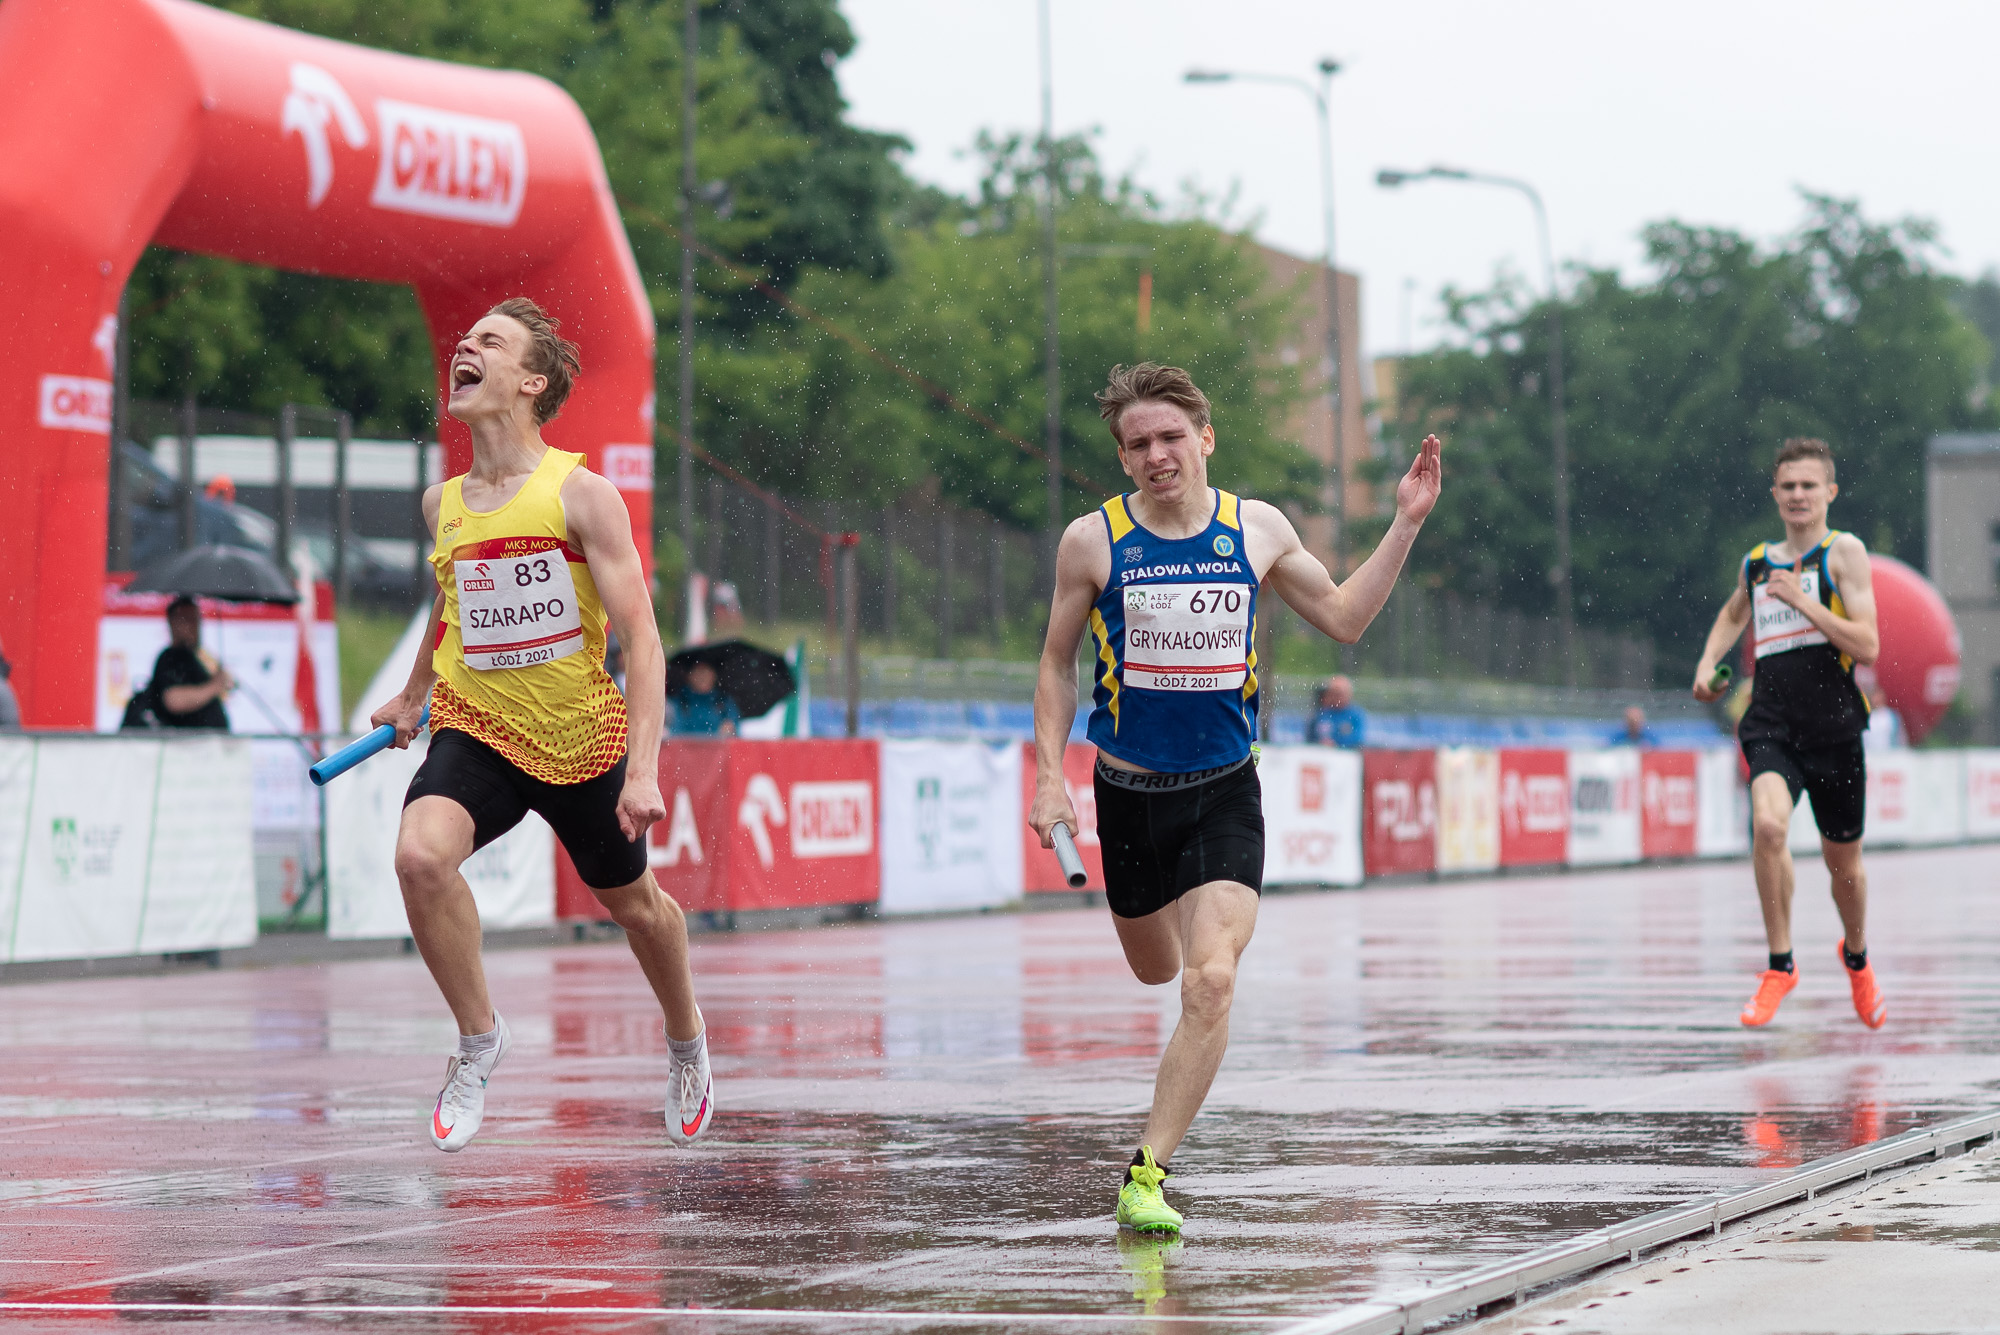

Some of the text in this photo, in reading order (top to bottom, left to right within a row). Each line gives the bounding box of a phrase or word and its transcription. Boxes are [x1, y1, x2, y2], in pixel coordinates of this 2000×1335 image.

[504, 540, 557, 551] MKS MOS
[514, 559, 551, 587] 83
[1121, 561, 1242, 583] STALOWA WOLA
[465, 581, 493, 591] ORLEN
[1190, 590, 1241, 614] 670
[469, 598, 564, 629] SZARAPO
[1130, 629, 1242, 650] GRYKAŁOWSKI
[491, 648, 555, 667] ŁÓDŹ 2021
[1153, 674, 1218, 688] ŁÓDŹ 2021
[1128, 773, 1180, 789] PRO
